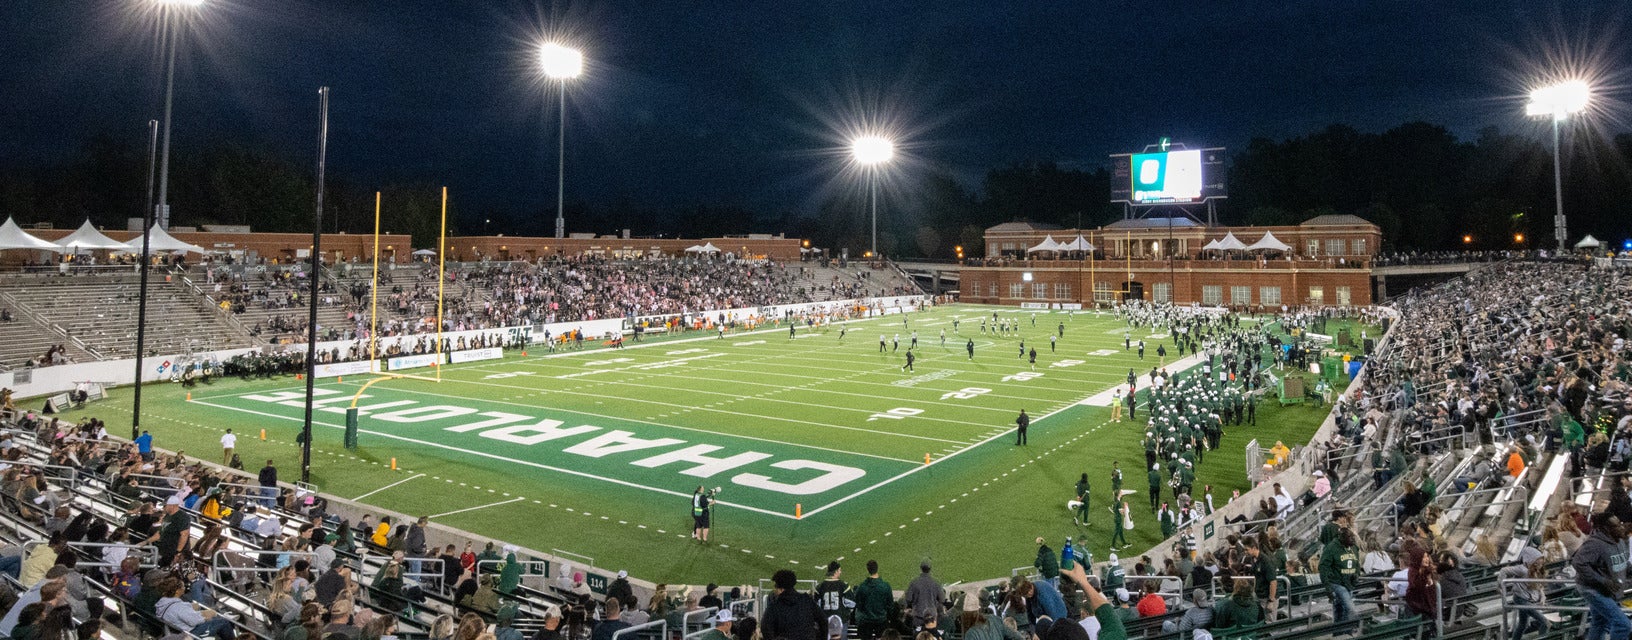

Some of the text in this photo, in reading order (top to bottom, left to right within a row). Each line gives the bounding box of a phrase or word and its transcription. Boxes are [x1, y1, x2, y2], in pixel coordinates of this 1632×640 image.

[940, 387, 993, 400] 20
[866, 407, 925, 422] 10
[240, 386, 867, 495] CHARLOTTE
[590, 577, 604, 590] 114
[823, 591, 840, 610] 15
